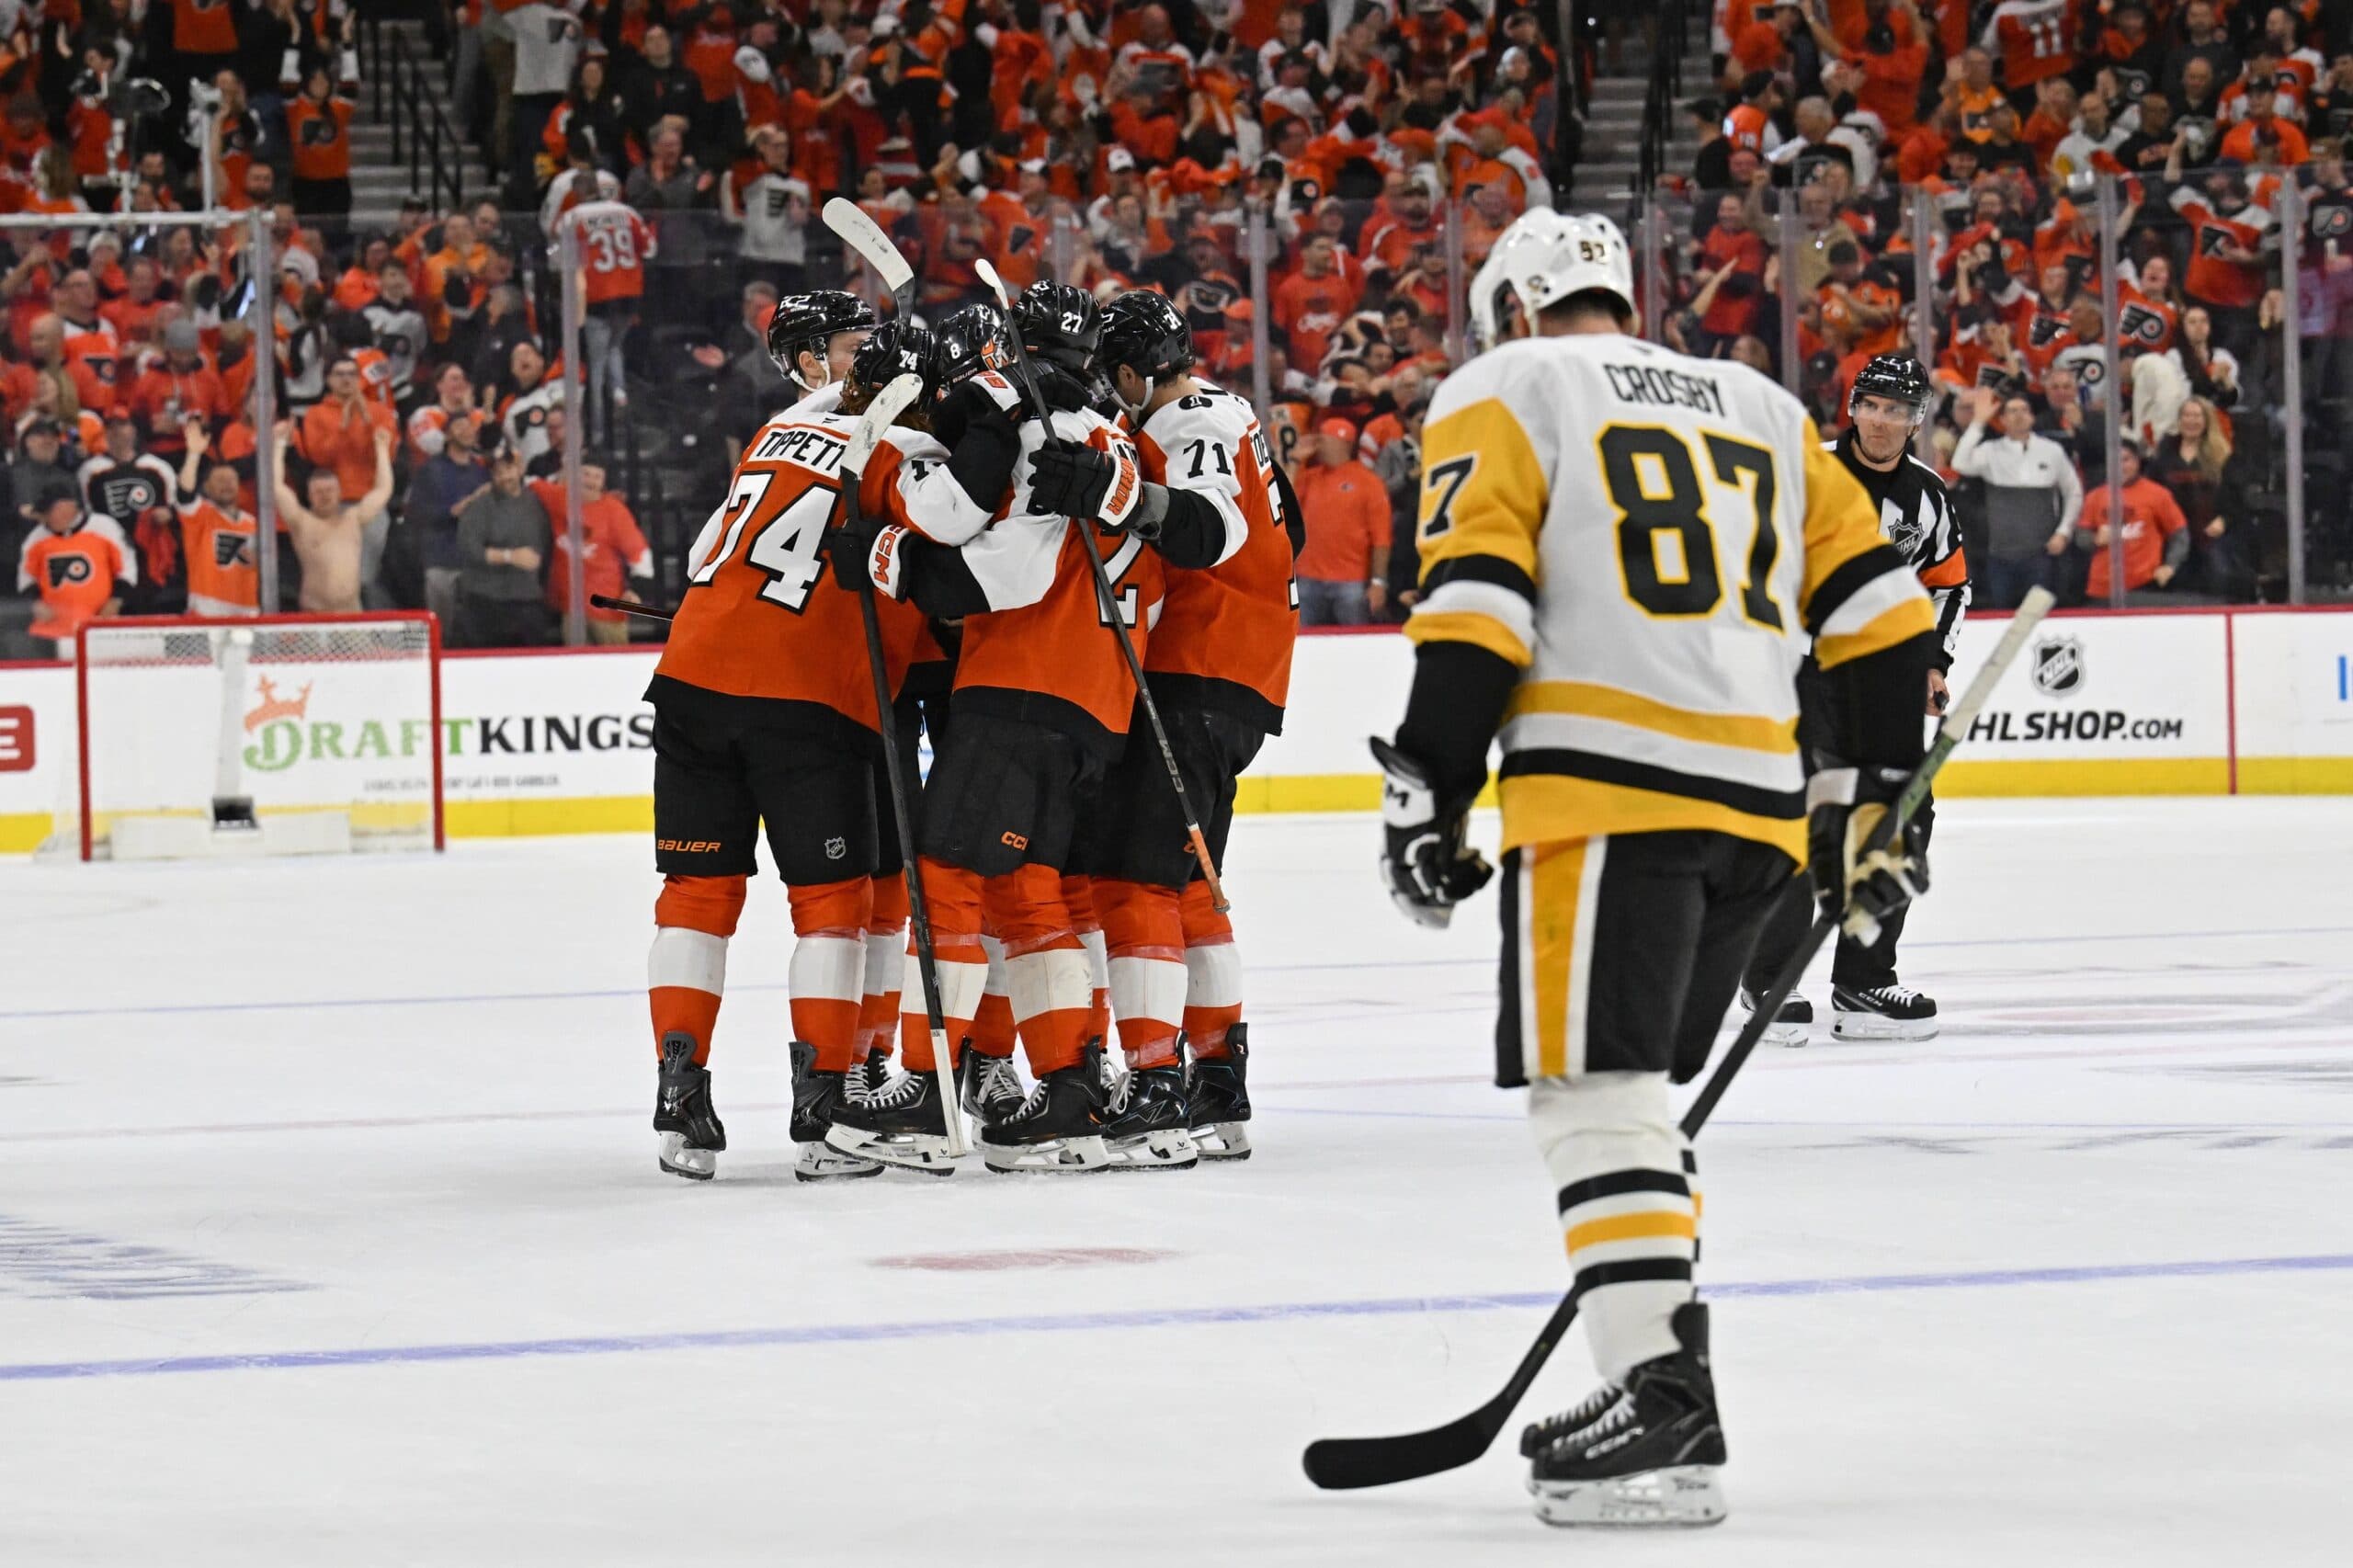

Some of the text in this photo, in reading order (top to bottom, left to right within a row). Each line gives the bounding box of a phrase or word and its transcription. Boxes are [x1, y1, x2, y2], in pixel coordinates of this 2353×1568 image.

[589, 229, 635, 273] 39
[1060, 312, 1083, 334] 27
[898, 348, 919, 369] 74
[949, 343, 961, 359] 8
[1603, 363, 1726, 417] CROSBY
[1183, 438, 1233, 479] 71
[689, 470, 843, 616] 74
[1594, 422, 1786, 636] 87
[242, 713, 654, 773] DRAFTKINGS
[1969, 710, 2184, 742] HLSHOP.COM
[1000, 831, 1029, 851] CC
